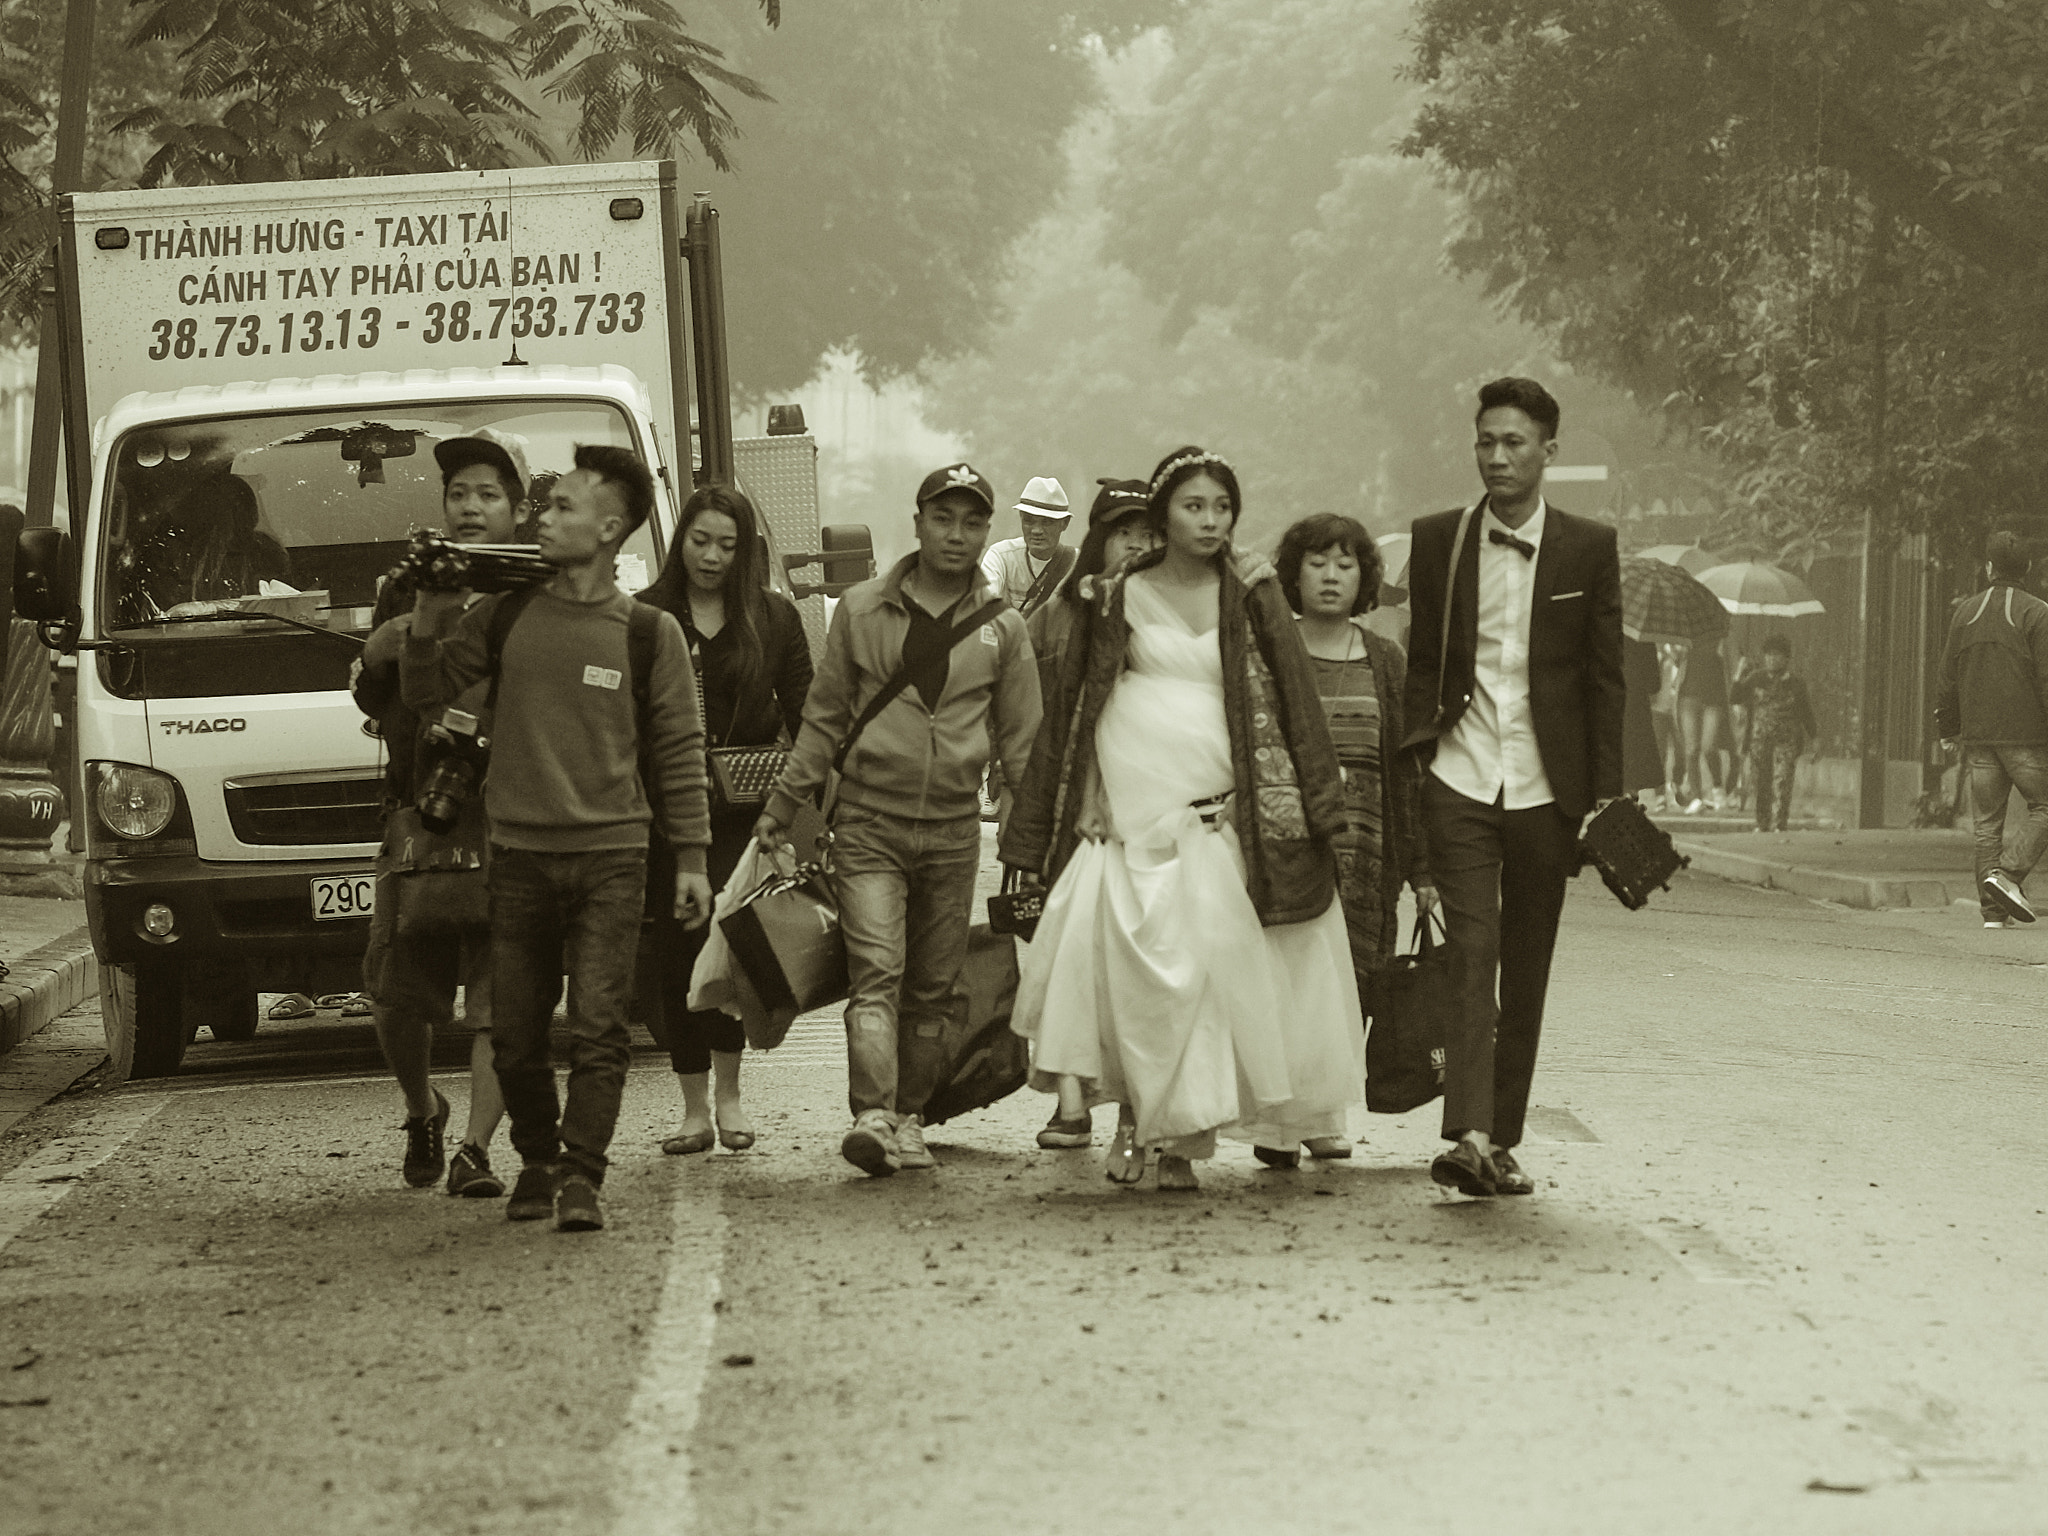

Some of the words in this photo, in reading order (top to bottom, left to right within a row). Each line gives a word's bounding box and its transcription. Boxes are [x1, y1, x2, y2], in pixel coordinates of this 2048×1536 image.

[134, 218, 243, 261] THÀNH
[253, 216, 346, 255] HƯNG
[375, 214, 448, 248] TAXI
[457, 199, 510, 244] TẢI
[178, 264, 267, 306] CÁNH
[277, 266, 342, 300] TAY
[350, 252, 424, 297] PHẢI
[434, 248, 502, 292] CỦA
[511, 253, 581, 293] BẠN
[593, 251, 602, 283] !
[148, 306, 382, 361] 38.73.13.13
[422, 291, 646, 345] 38.733.733
[160, 718, 246, 735] THACO
[318, 881, 372, 914] 29C
